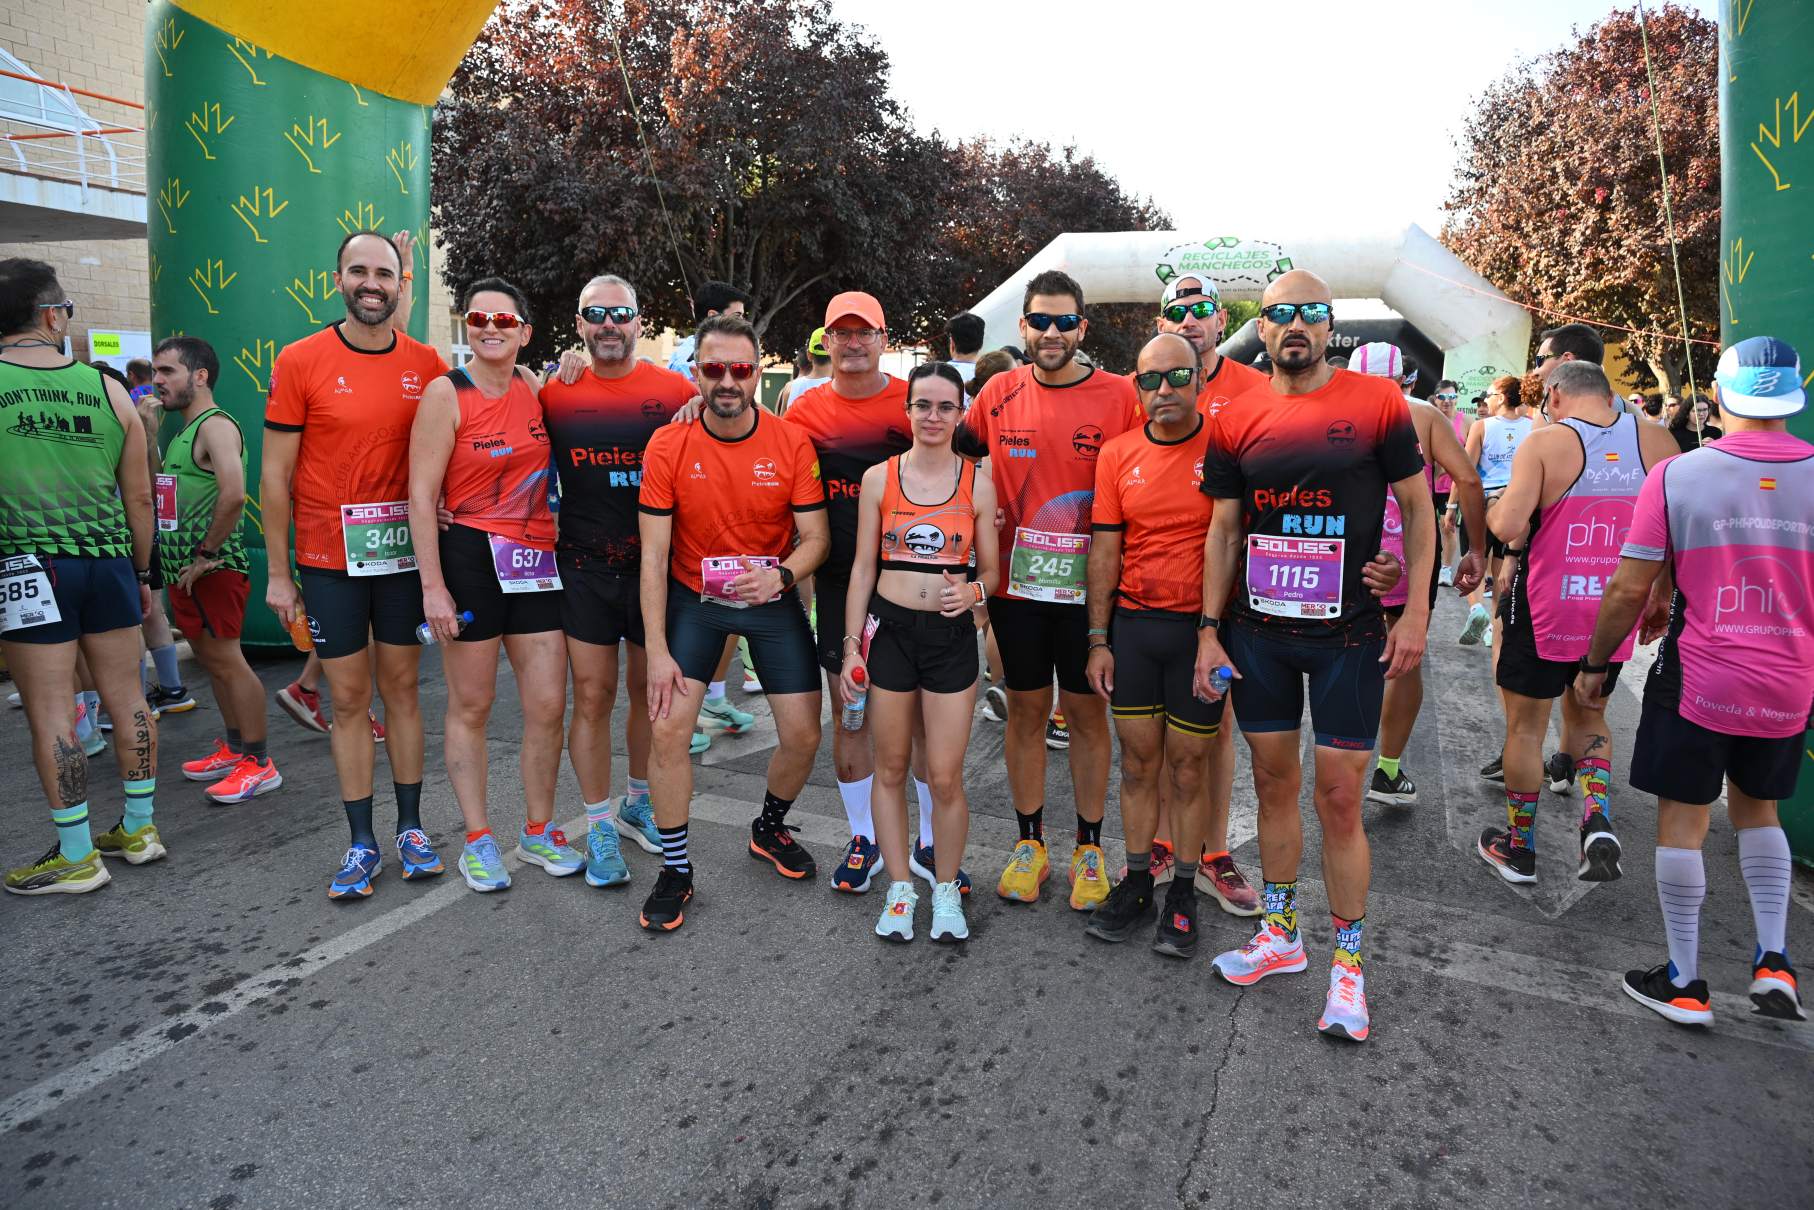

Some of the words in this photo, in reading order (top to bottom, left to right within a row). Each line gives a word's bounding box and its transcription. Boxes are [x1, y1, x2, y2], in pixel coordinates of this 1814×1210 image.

[1178, 260, 1272, 271] MANCHEGOS
[1182, 251, 1270, 262] RECICLAJES
[0, 389, 32, 408] DON'T
[31, 389, 74, 406] THINK,
[77, 392, 101, 409] RUN
[473, 440, 506, 451] Pieles
[1000, 435, 1030, 446] Pieles
[1009, 448, 1037, 458] RUN
[609, 470, 642, 487] RU
[827, 479, 861, 499] Pie
[1254, 485, 1333, 512] Pieles
[1282, 513, 1345, 535] RUN
[366, 526, 409, 549] 340
[1022, 532, 1083, 549] SOLISS
[1256, 538, 1335, 555] SOLISS
[512, 548, 543, 568] 637
[1029, 556, 1074, 577] 245
[1269, 564, 1320, 589] 1115
[1283, 591, 1303, 599] Pedro
[1715, 576, 1774, 623] phi
[1696, 695, 1742, 715] Poveda
[1745, 706, 1757, 717] &
